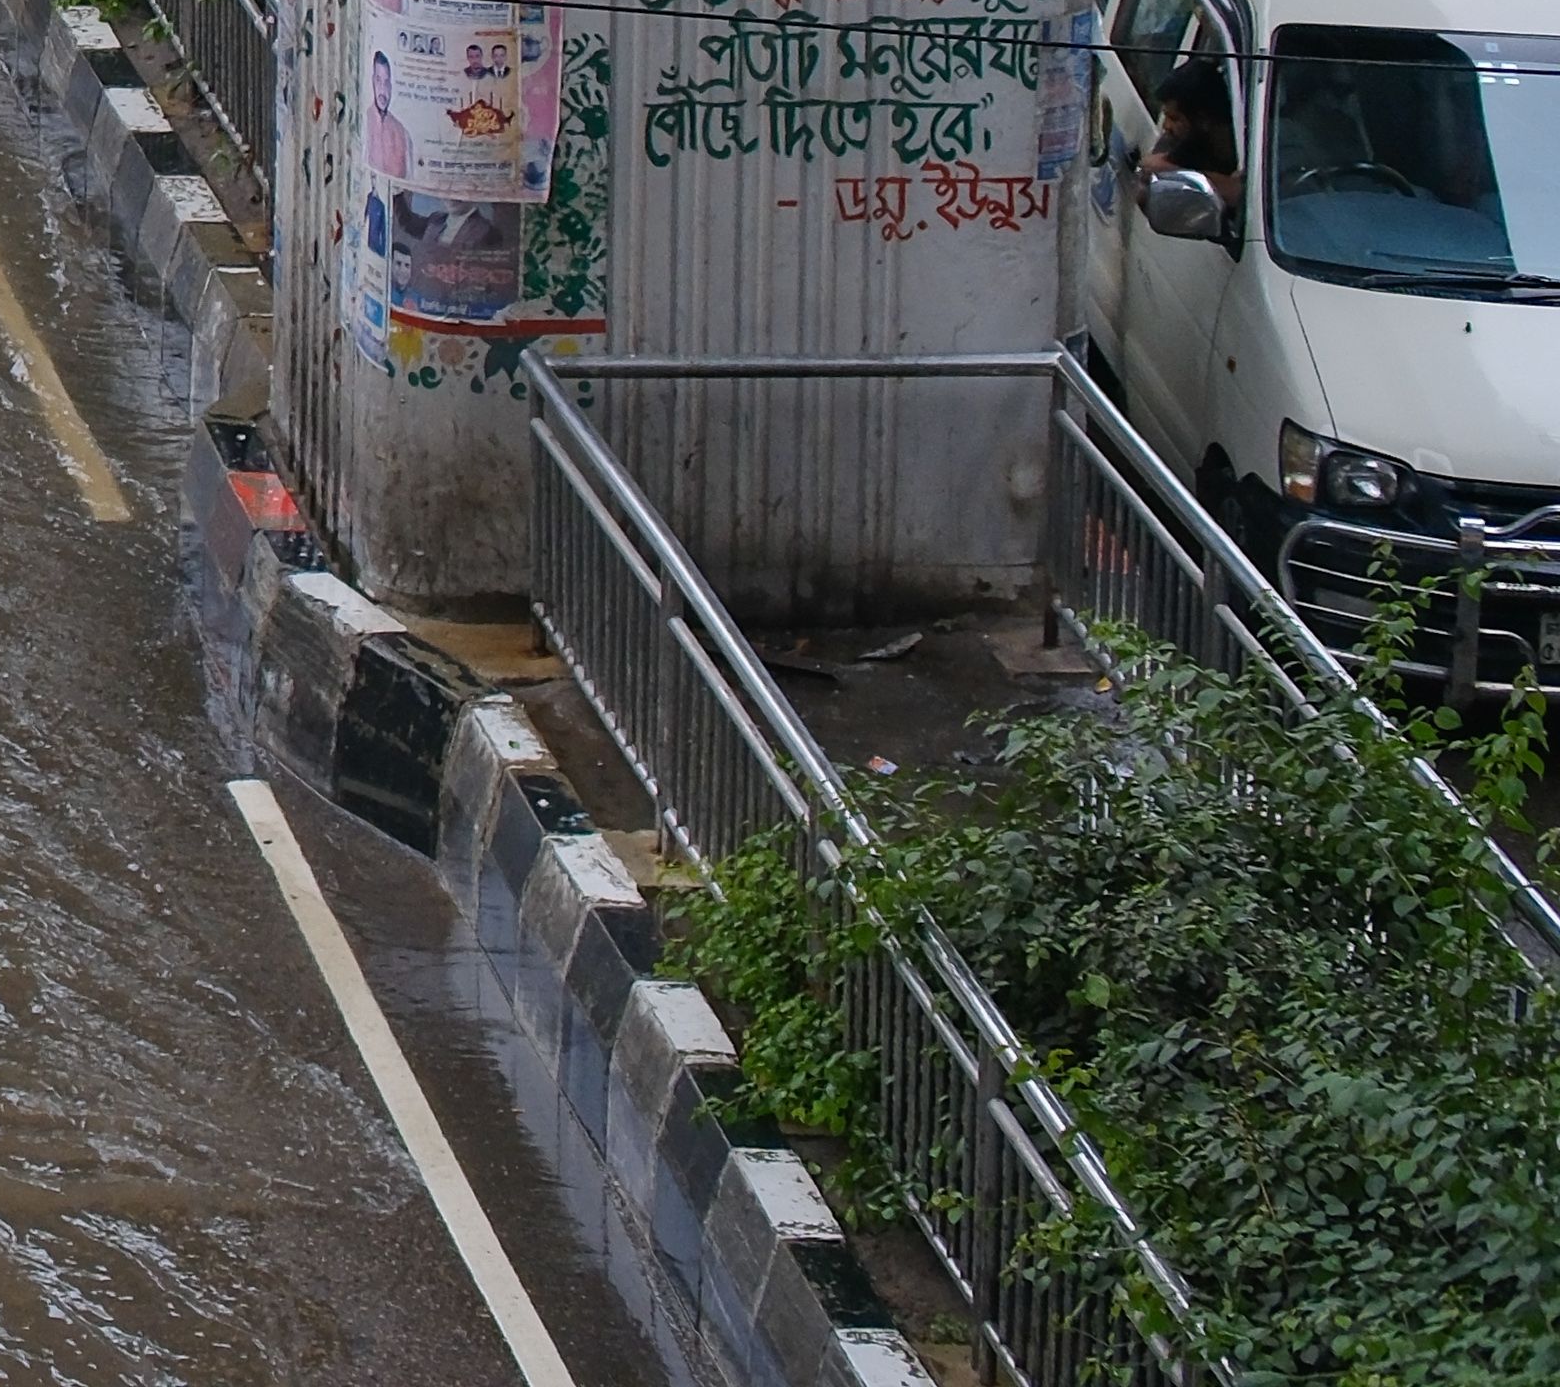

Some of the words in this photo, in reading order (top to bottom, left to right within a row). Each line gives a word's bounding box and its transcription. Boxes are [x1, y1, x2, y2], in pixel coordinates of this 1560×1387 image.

[698, 9, 820, 94] প্রতিটি
[642, 65, 760, 167] পৌঁছে
[760, 87, 878, 163] দিতে
